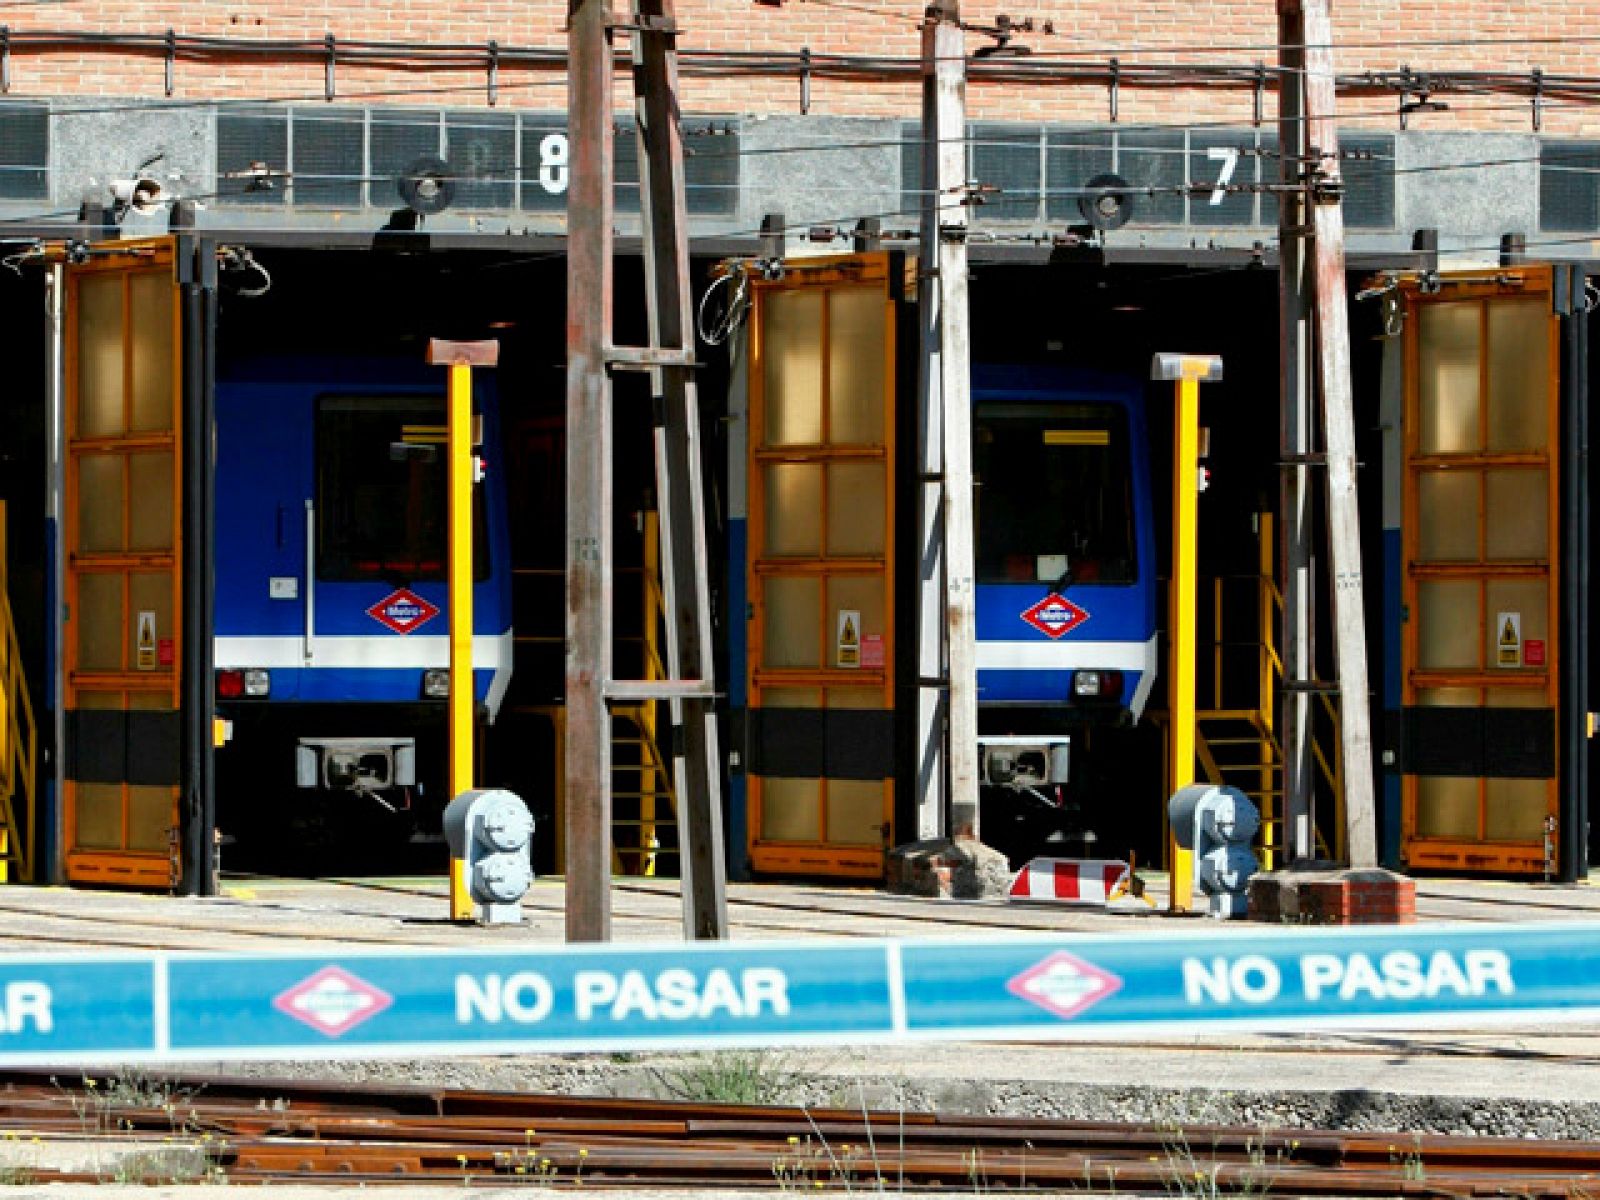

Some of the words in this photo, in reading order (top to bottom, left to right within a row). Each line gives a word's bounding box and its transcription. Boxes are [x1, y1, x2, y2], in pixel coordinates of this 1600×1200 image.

[539, 134, 568, 194] 8
[1207, 147, 1238, 205] 7
[454, 972, 554, 1024] NO
[574, 967, 790, 1021] PASAR
[1182, 953, 1281, 1005] NO
[1300, 949, 1516, 1001] PASAR
[0, 981, 53, 1033] R
